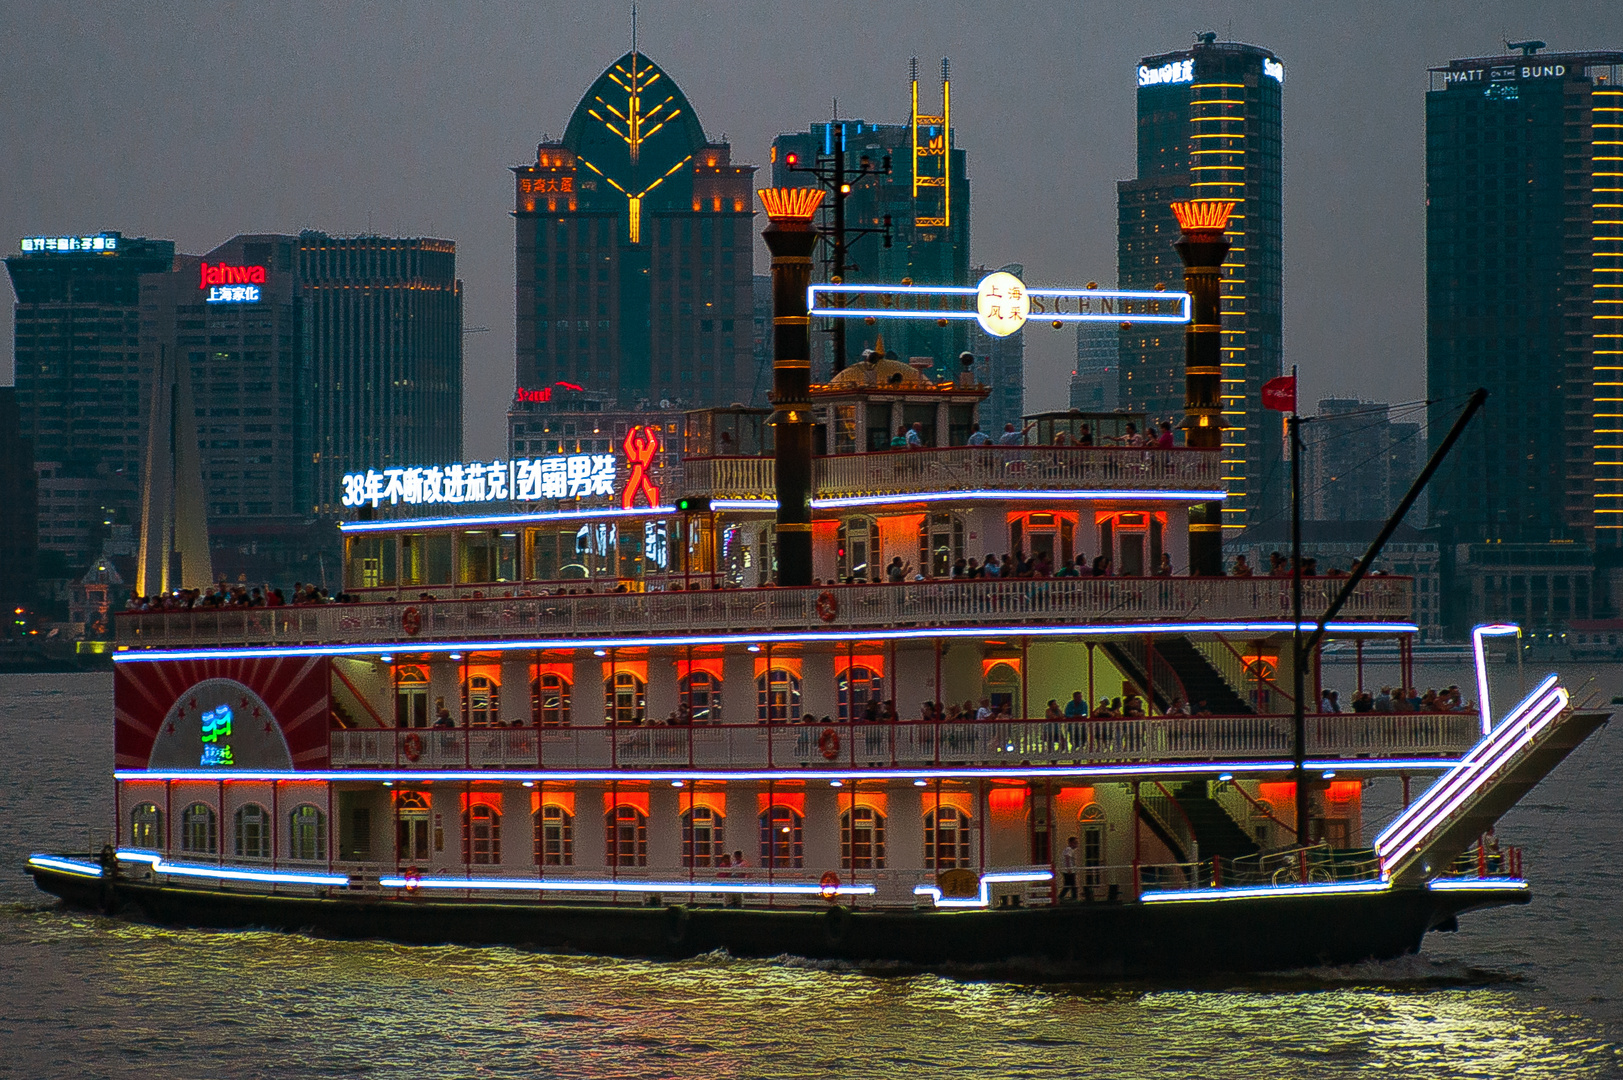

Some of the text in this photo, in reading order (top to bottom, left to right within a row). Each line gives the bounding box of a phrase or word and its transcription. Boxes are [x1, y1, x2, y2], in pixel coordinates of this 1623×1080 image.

[1443, 69, 1484, 83] HYATT
[1521, 65, 1566, 78] BUND
[199, 261, 266, 290] Jahwa
[205, 286, 260, 302] 上海家化
[985, 285, 1023, 301] 上海
[987, 305, 1023, 321] 风采
